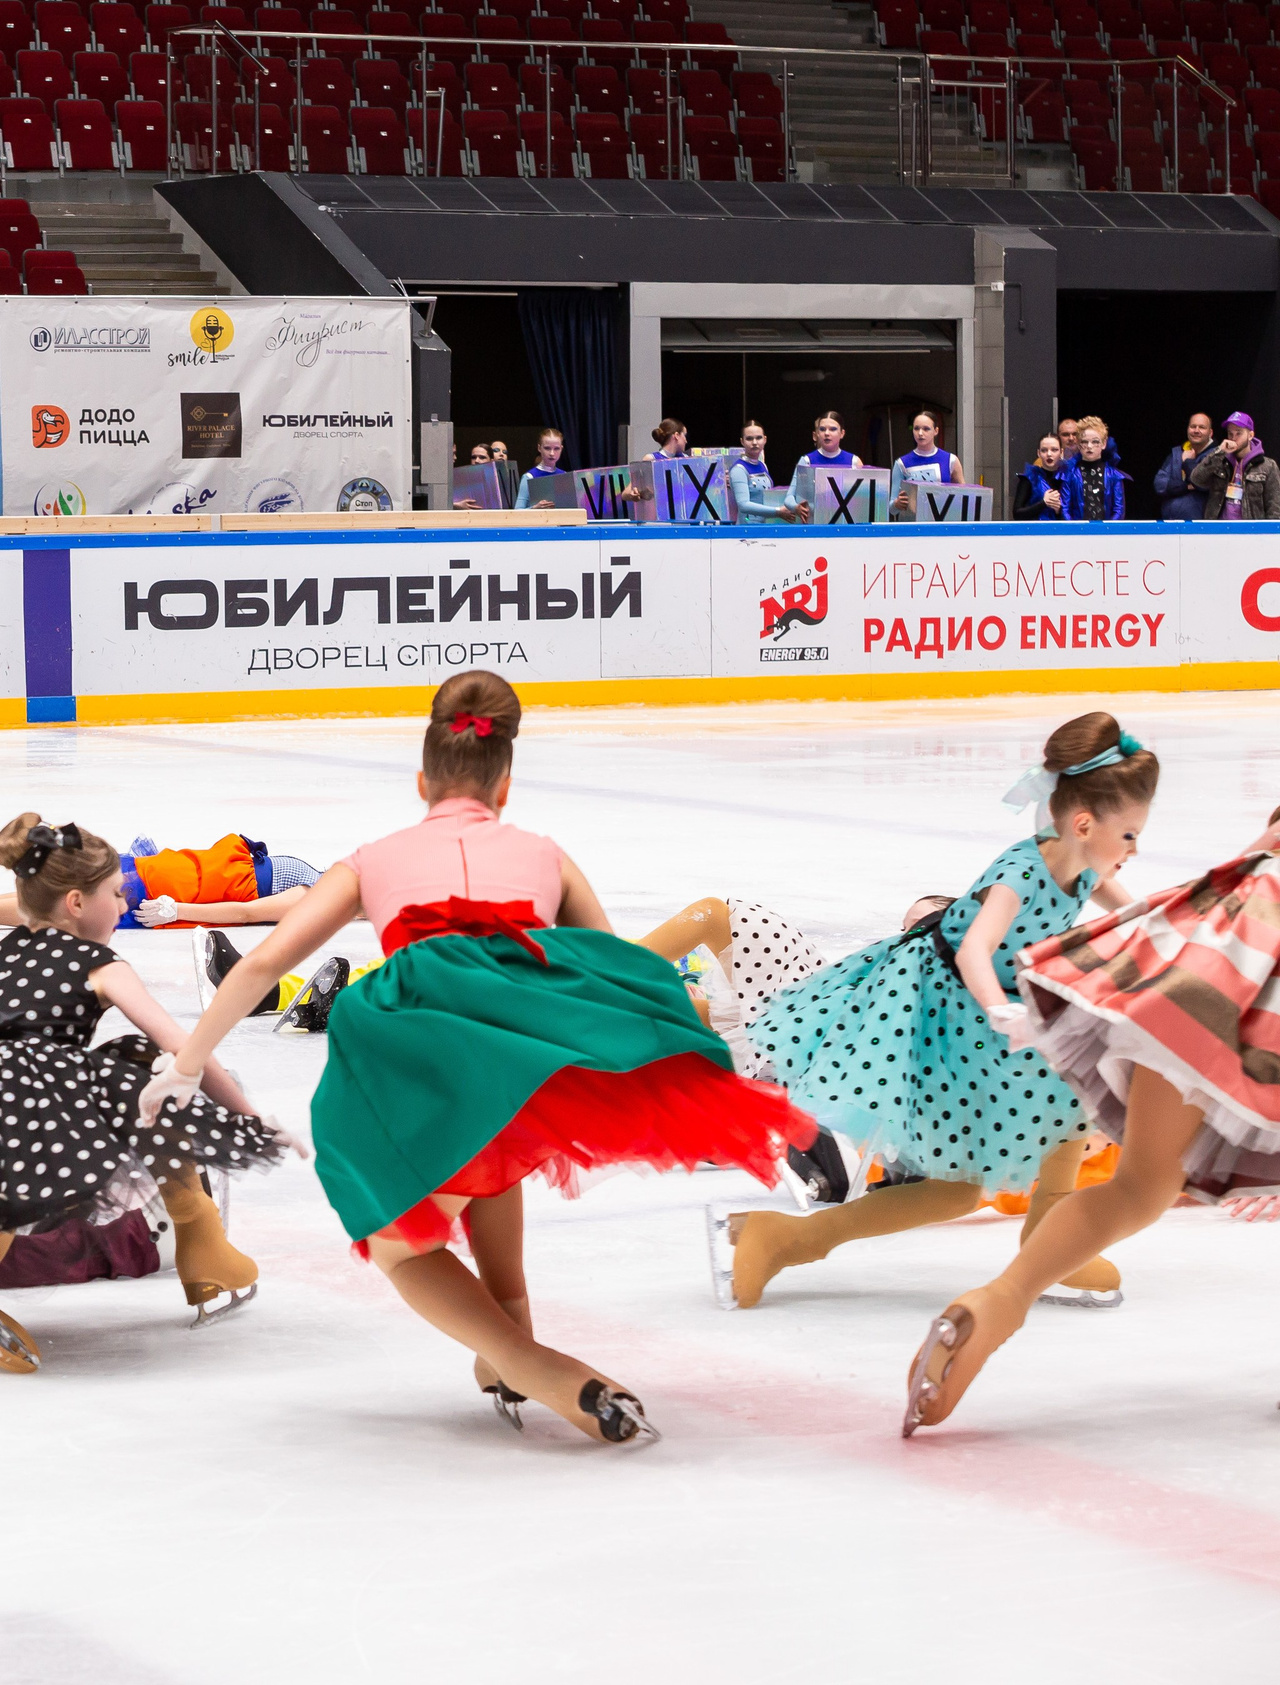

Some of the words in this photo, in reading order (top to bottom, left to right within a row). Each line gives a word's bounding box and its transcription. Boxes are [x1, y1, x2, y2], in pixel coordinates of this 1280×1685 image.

[54, 327, 151, 345] ИЛАССТРОЙ
[167, 346, 208, 367] smile
[79, 408, 136, 425] ДОДО
[262, 411, 393, 428] ЮБИЛЕЙНЫЙ
[79, 428, 150, 447] ПИЦЦА
[293, 431, 328, 439] ДВОРЕЦ
[330, 430, 364, 438] СПОРТА
[665, 462, 721, 520] IX
[827, 476, 876, 524] XI
[355, 499, 373, 507] Стоп
[759, 568, 812, 597] РАДИО
[863, 554, 977, 599] ИГРАЙ
[992, 560, 1130, 598] ВМЕСТЕ
[1142, 559, 1166, 596] С
[123, 556, 643, 631] ЮБИЛЕЙНЫЙ
[863, 615, 1007, 660] РАДИО
[1020, 613, 1166, 651] ENERGY
[247, 645, 388, 675] ДВОРЕЦ
[397, 641, 529, 667] СПОРТА
[761, 648, 803, 661] ENERGY
[804, 647, 828, 660] 95.0
